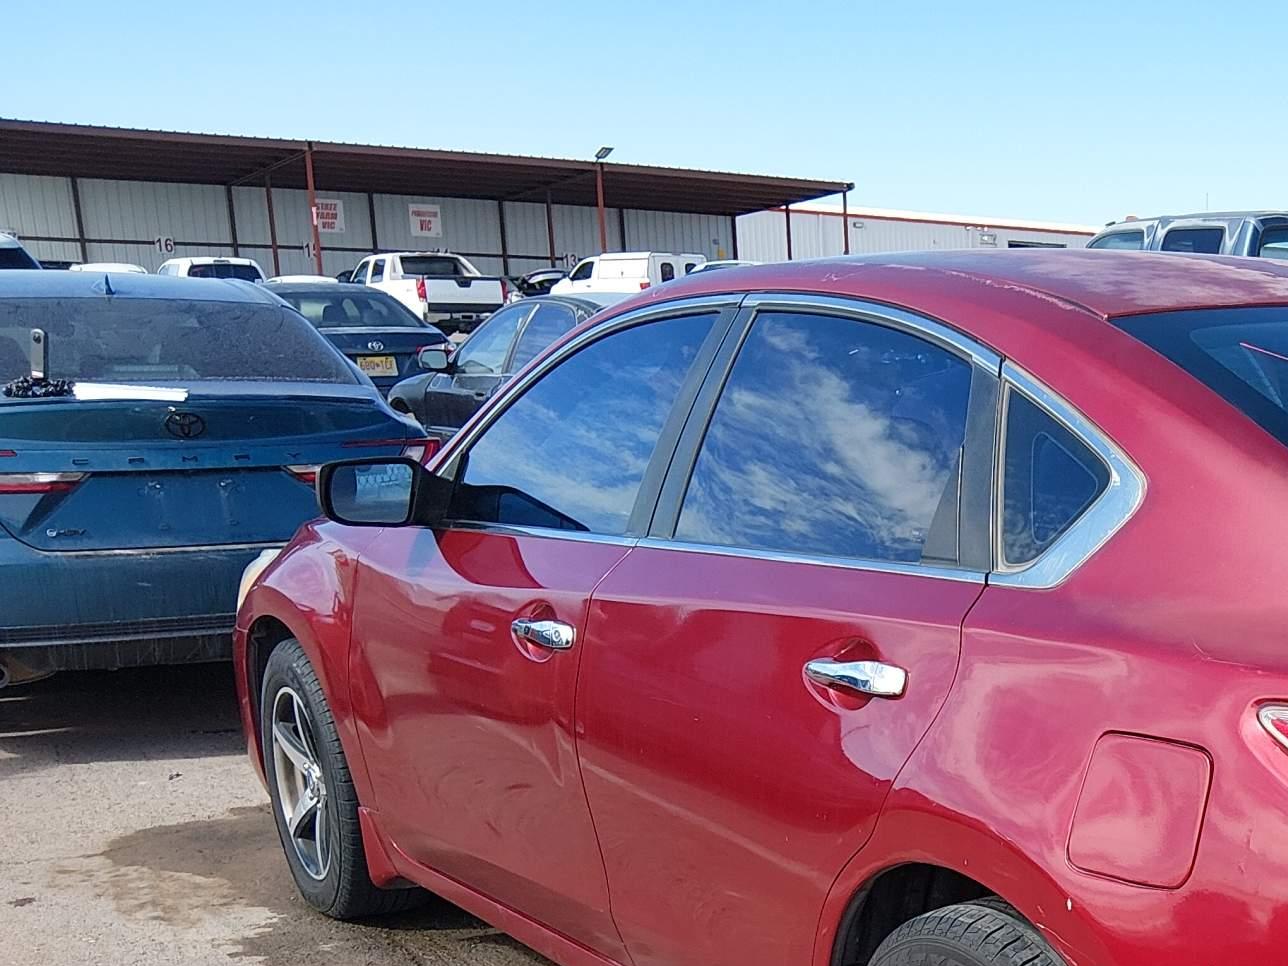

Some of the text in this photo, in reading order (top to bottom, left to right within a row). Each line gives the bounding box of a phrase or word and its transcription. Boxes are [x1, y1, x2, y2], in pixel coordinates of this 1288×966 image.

[419, 219, 432, 232] VIC
[155, 238, 174, 253] 16
[563, 253, 577, 268] 13
[72, 452, 301, 466] CAMRY
